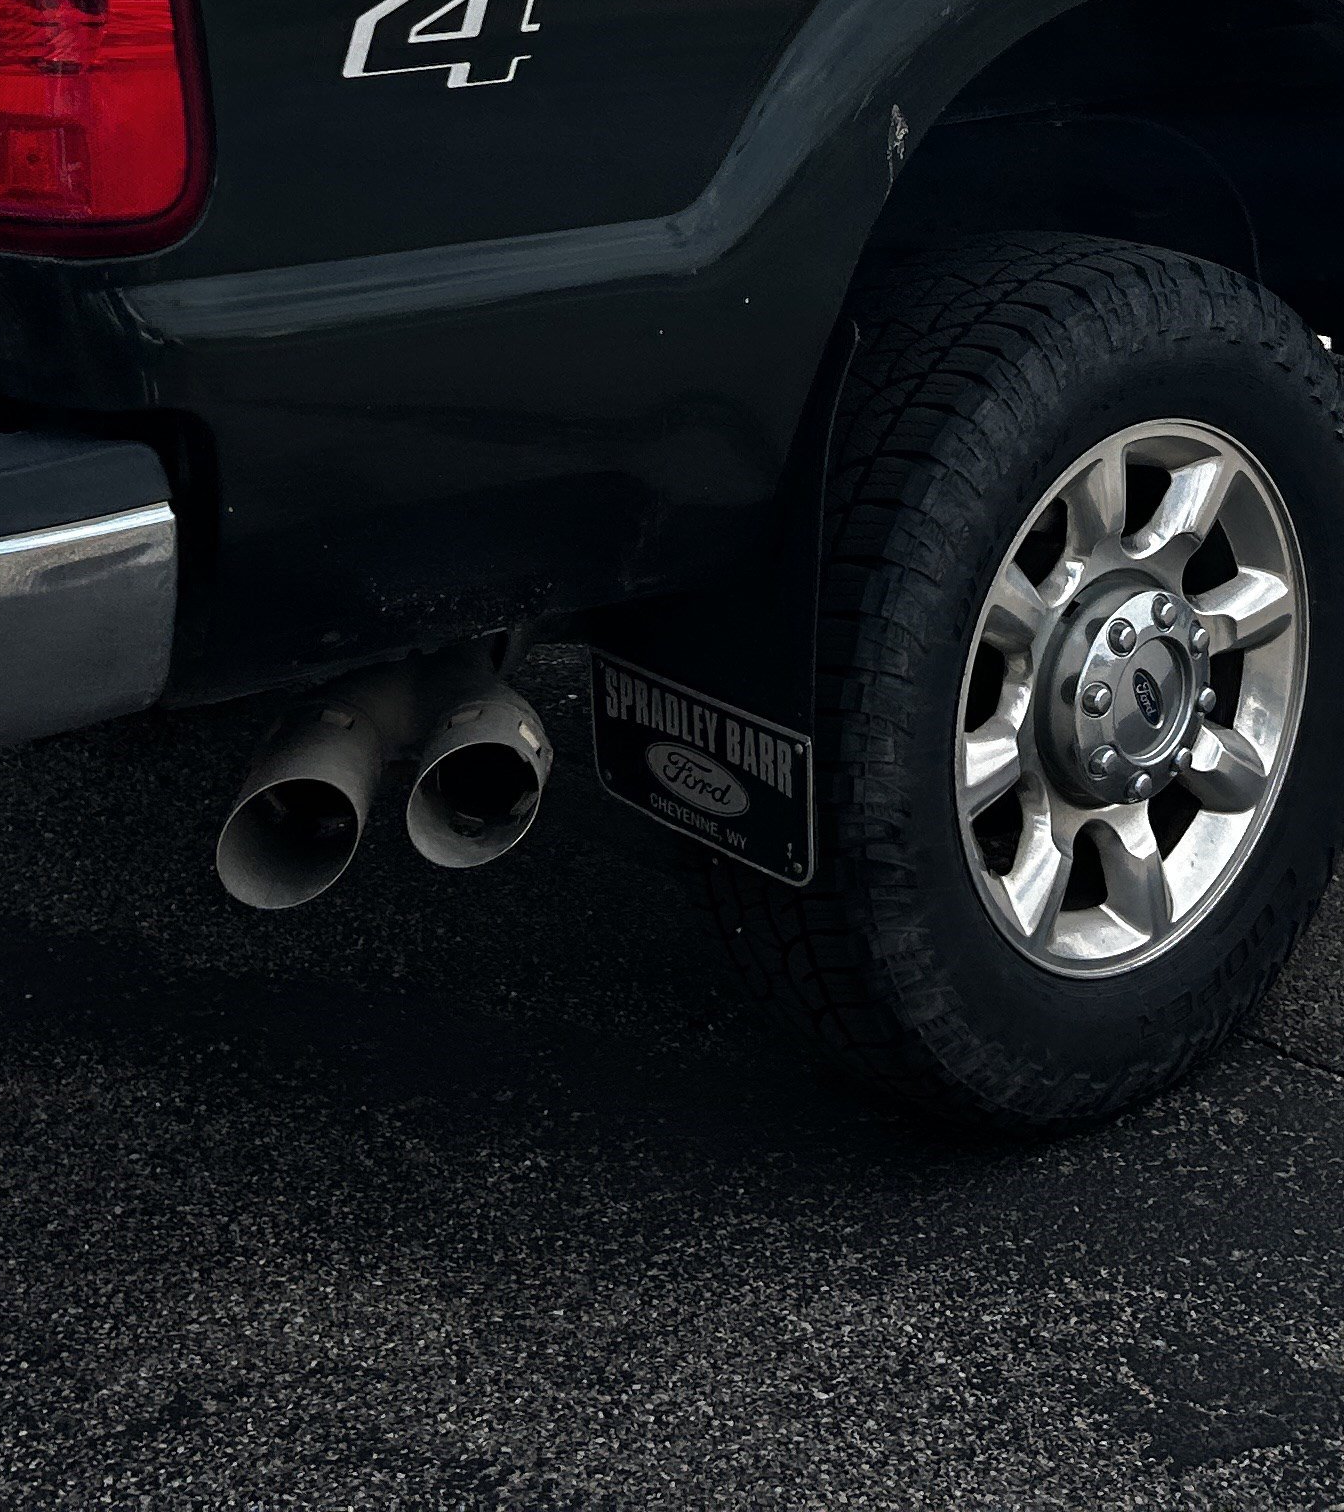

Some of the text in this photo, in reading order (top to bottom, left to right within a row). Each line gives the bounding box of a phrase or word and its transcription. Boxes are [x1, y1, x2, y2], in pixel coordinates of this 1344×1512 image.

[1135, 681, 1157, 717] Ford
[605, 665, 793, 799] SPRADLEY BARR
[662, 751, 732, 806] Ford
[649, 791, 748, 851] CHEYENNE, WY
